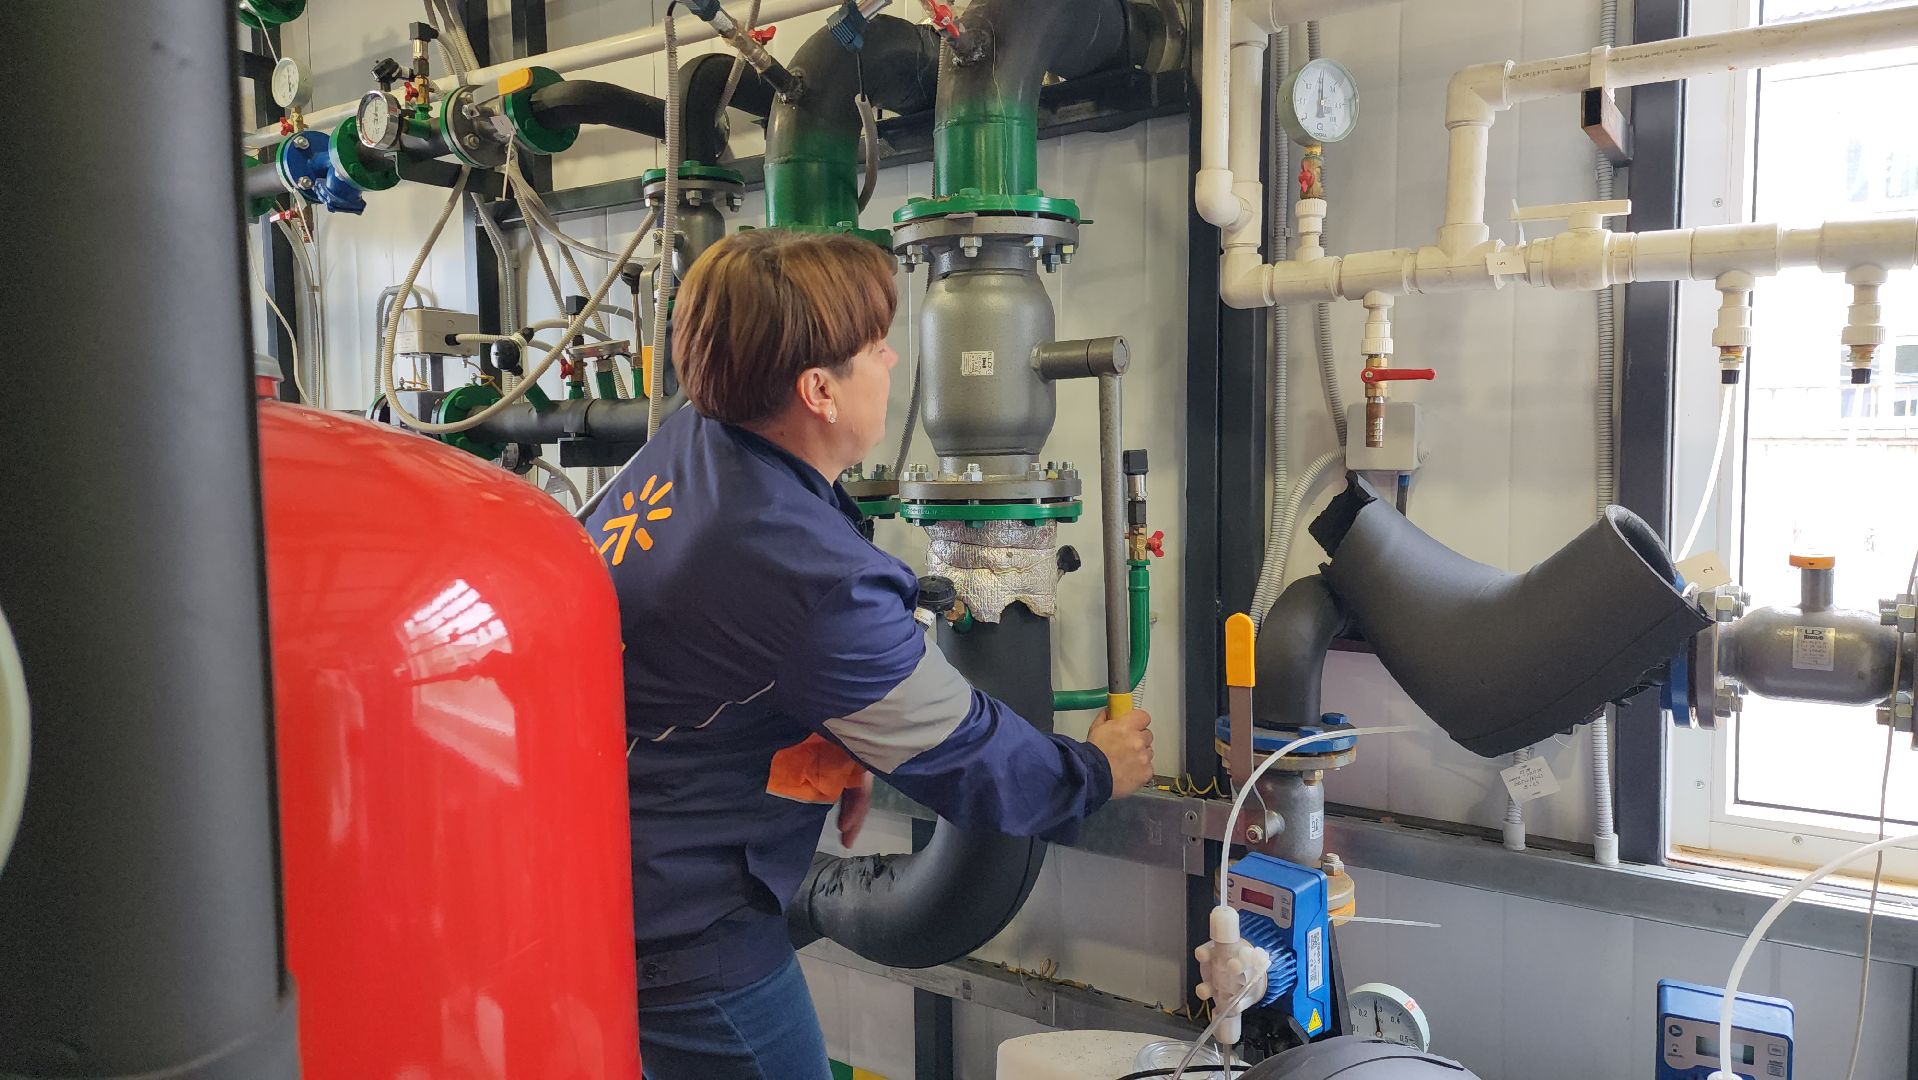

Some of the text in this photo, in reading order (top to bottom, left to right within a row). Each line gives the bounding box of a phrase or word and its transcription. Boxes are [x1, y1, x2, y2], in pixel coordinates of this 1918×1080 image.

[1358, 1008, 1368, 1018] 0.2
[1390, 1016, 1401, 1025] 0.4
[1399, 1034, 1409, 1043] 0.5
